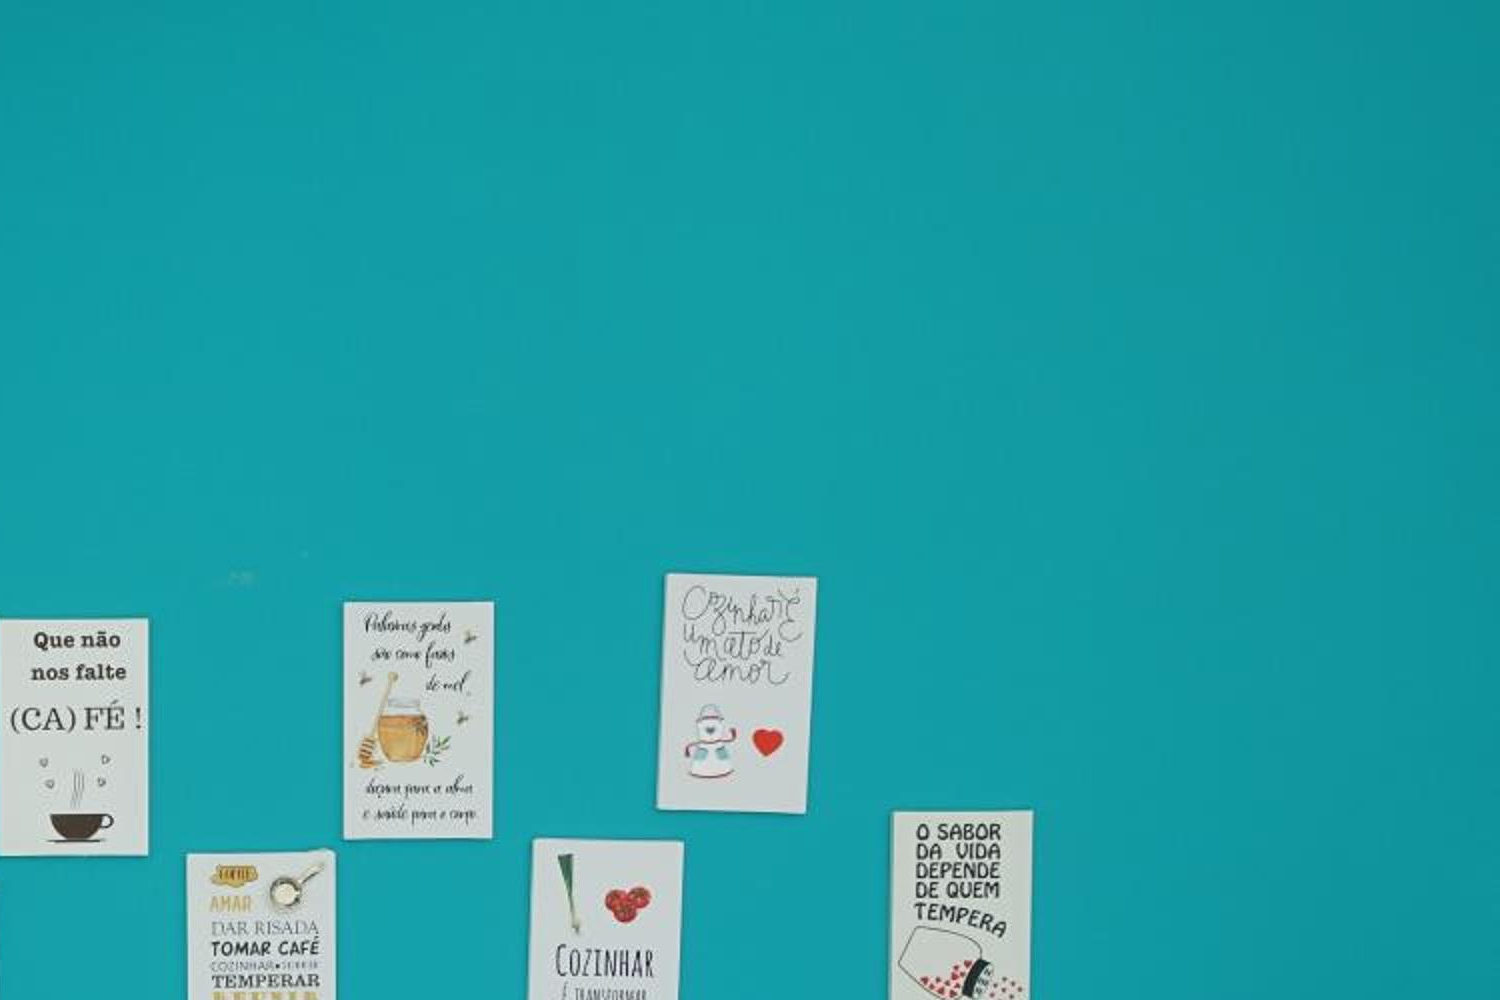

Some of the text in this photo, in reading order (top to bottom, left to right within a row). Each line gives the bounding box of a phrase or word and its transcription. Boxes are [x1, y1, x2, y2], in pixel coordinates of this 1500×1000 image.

[33, 631, 121, 650] Que não
[764, 634, 782, 656] de
[31, 664, 127, 680] nos falte
[916, 823, 1001, 840] O SABOR
[916, 843, 1001, 860] DA VIDA
[916, 862, 1001, 879] DEPENDE
[916, 881, 1000, 898] DE QUEM
[212, 920, 319, 936] DAR RISADA
[914, 902, 1007, 938] TEMPERA
[212, 936, 319, 957] TOMAR CAFÉ
[555, 944, 654, 978] COZINHAR
[212, 974, 320, 988] TEMPERAR
